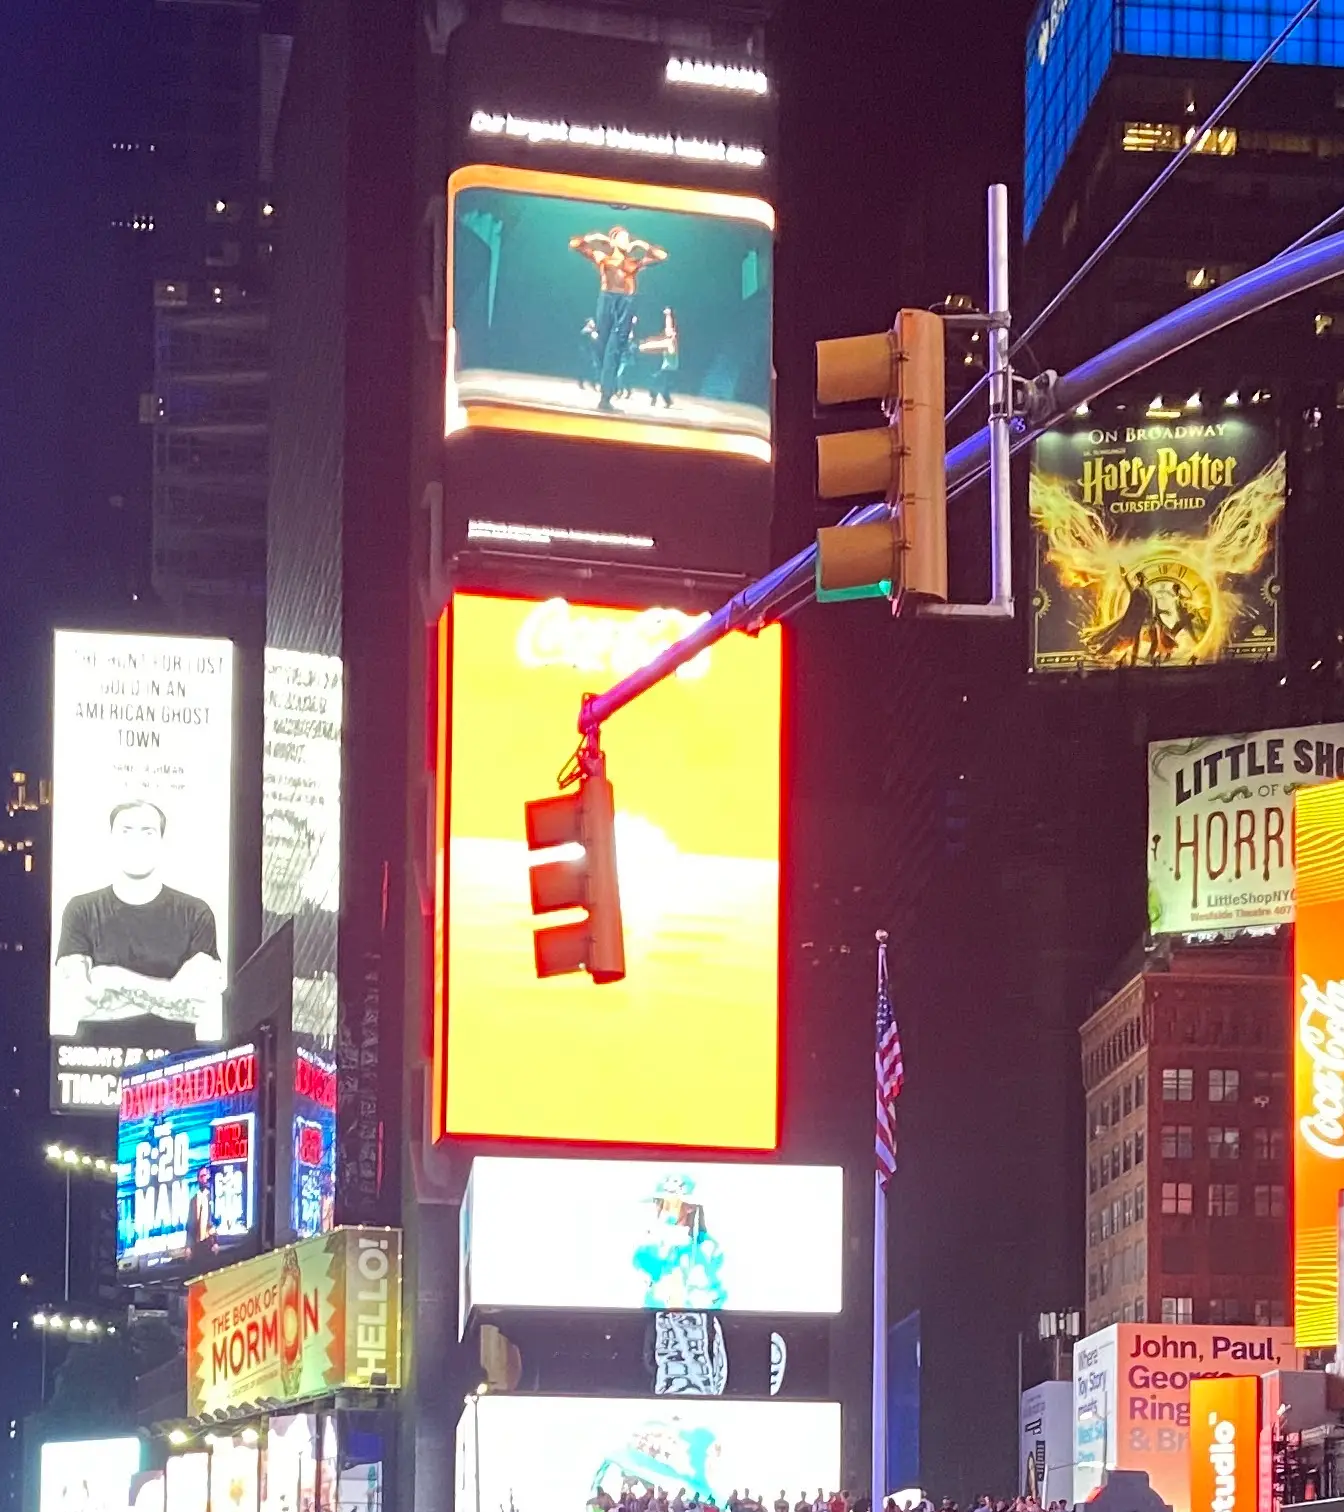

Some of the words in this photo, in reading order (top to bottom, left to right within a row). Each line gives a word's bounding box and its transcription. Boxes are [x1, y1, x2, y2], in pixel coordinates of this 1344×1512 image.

[1125, 423, 1228, 442] BROADWAY
[1109, 499, 1161, 513] CURSED
[1164, 497, 1206, 511] CHILD
[161, 705, 211, 726] GHOST
[118, 729, 161, 748] TOWN
[1175, 738, 1285, 807] LITTLE
[1257, 783, 1281, 798] OF
[1174, 806, 1296, 909] HORR
[58, 1045, 124, 1068] SUNDAYS
[124, 1047, 143, 1068] AT
[172, 1055, 255, 1104] BALDACCI
[135, 1132, 189, 1188] 6:20
[134, 1180, 190, 1234] MAN
[212, 1309, 230, 1335] THE
[232, 1294, 261, 1325] BOOK
[263, 1283, 278, 1307] OF
[356, 1238, 389, 1378] HELLO!
[212, 1287, 320, 1386] MORMON
[1130, 1334, 1204, 1362] John,
[1212, 1336, 1282, 1364] Paul,
[1129, 1394, 1190, 1427] Ring
